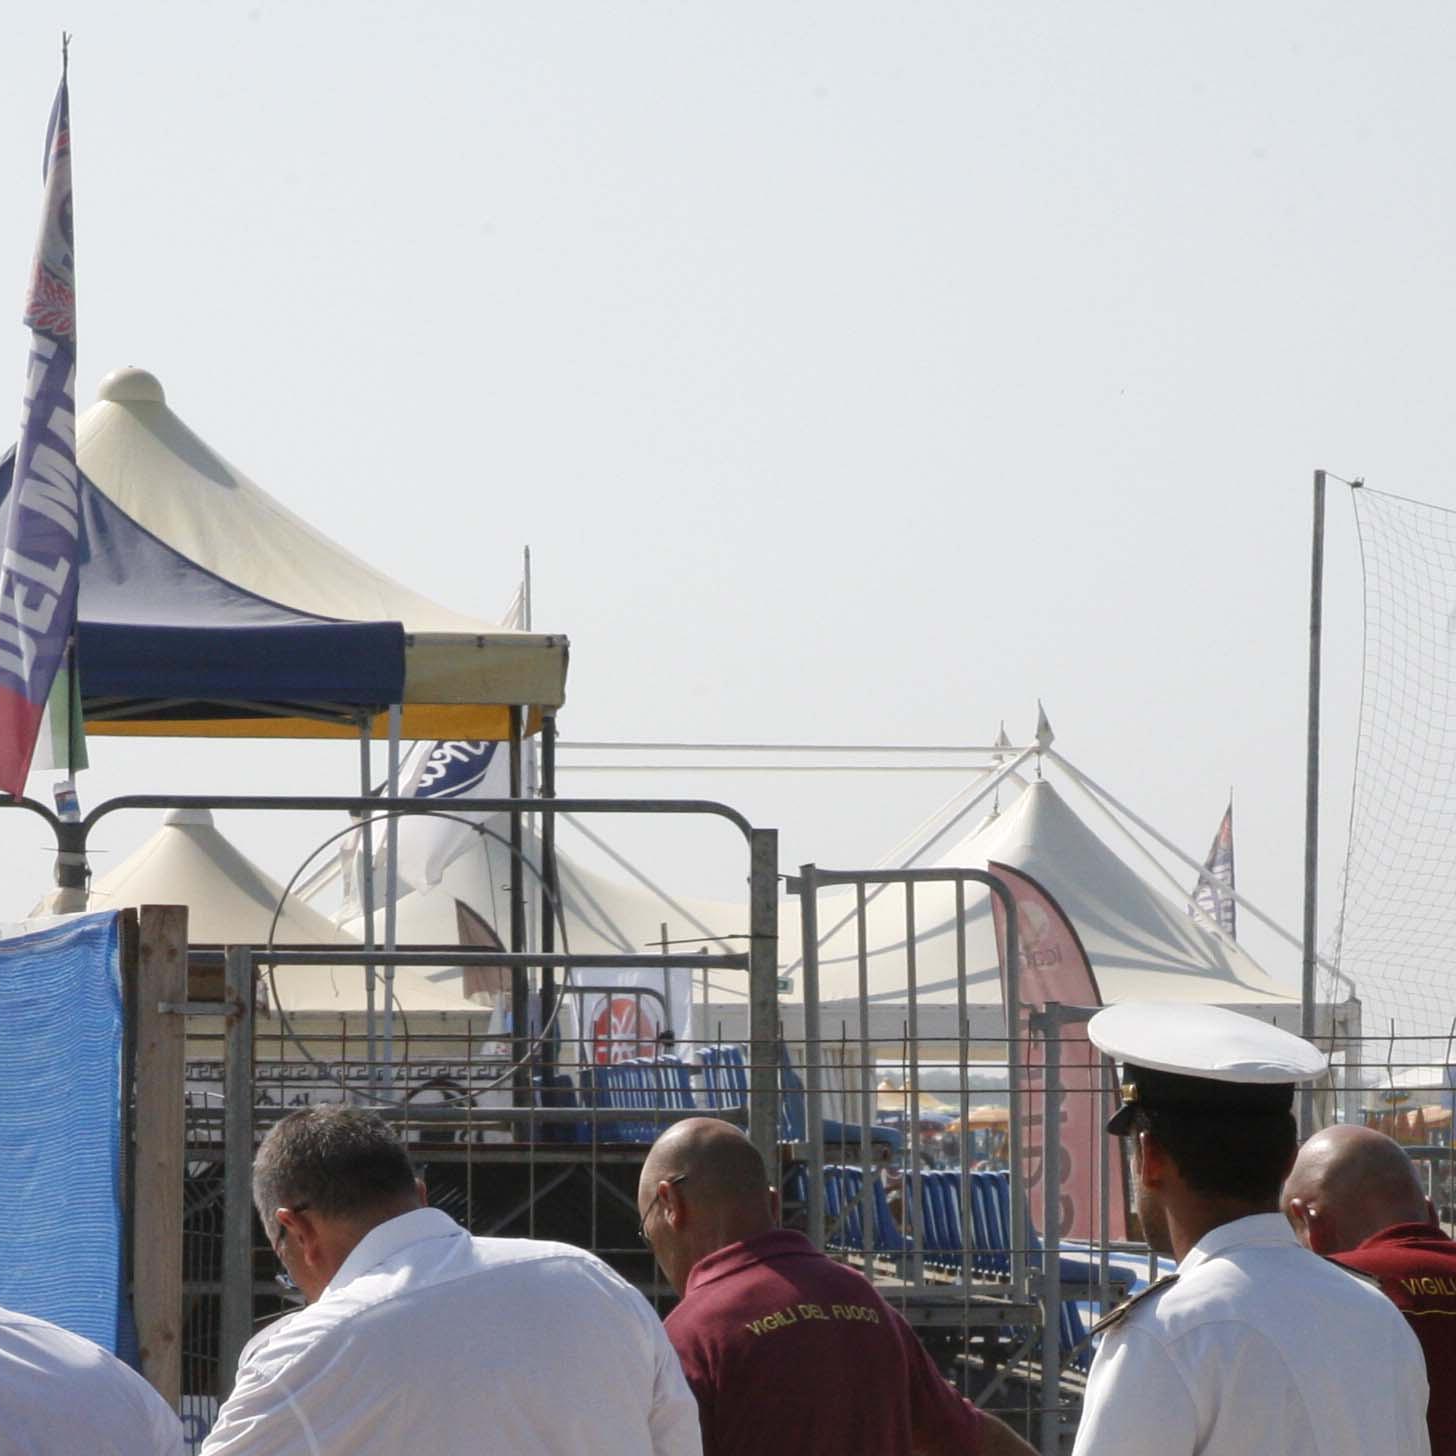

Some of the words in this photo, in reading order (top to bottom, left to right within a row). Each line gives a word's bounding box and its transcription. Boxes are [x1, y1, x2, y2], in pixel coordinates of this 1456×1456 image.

[1401, 1276, 1456, 1297] VIGILI
[745, 1306, 798, 1337] VIGILI
[798, 1303, 831, 1321] DEL
[831, 1304, 881, 1326] FUOCO
